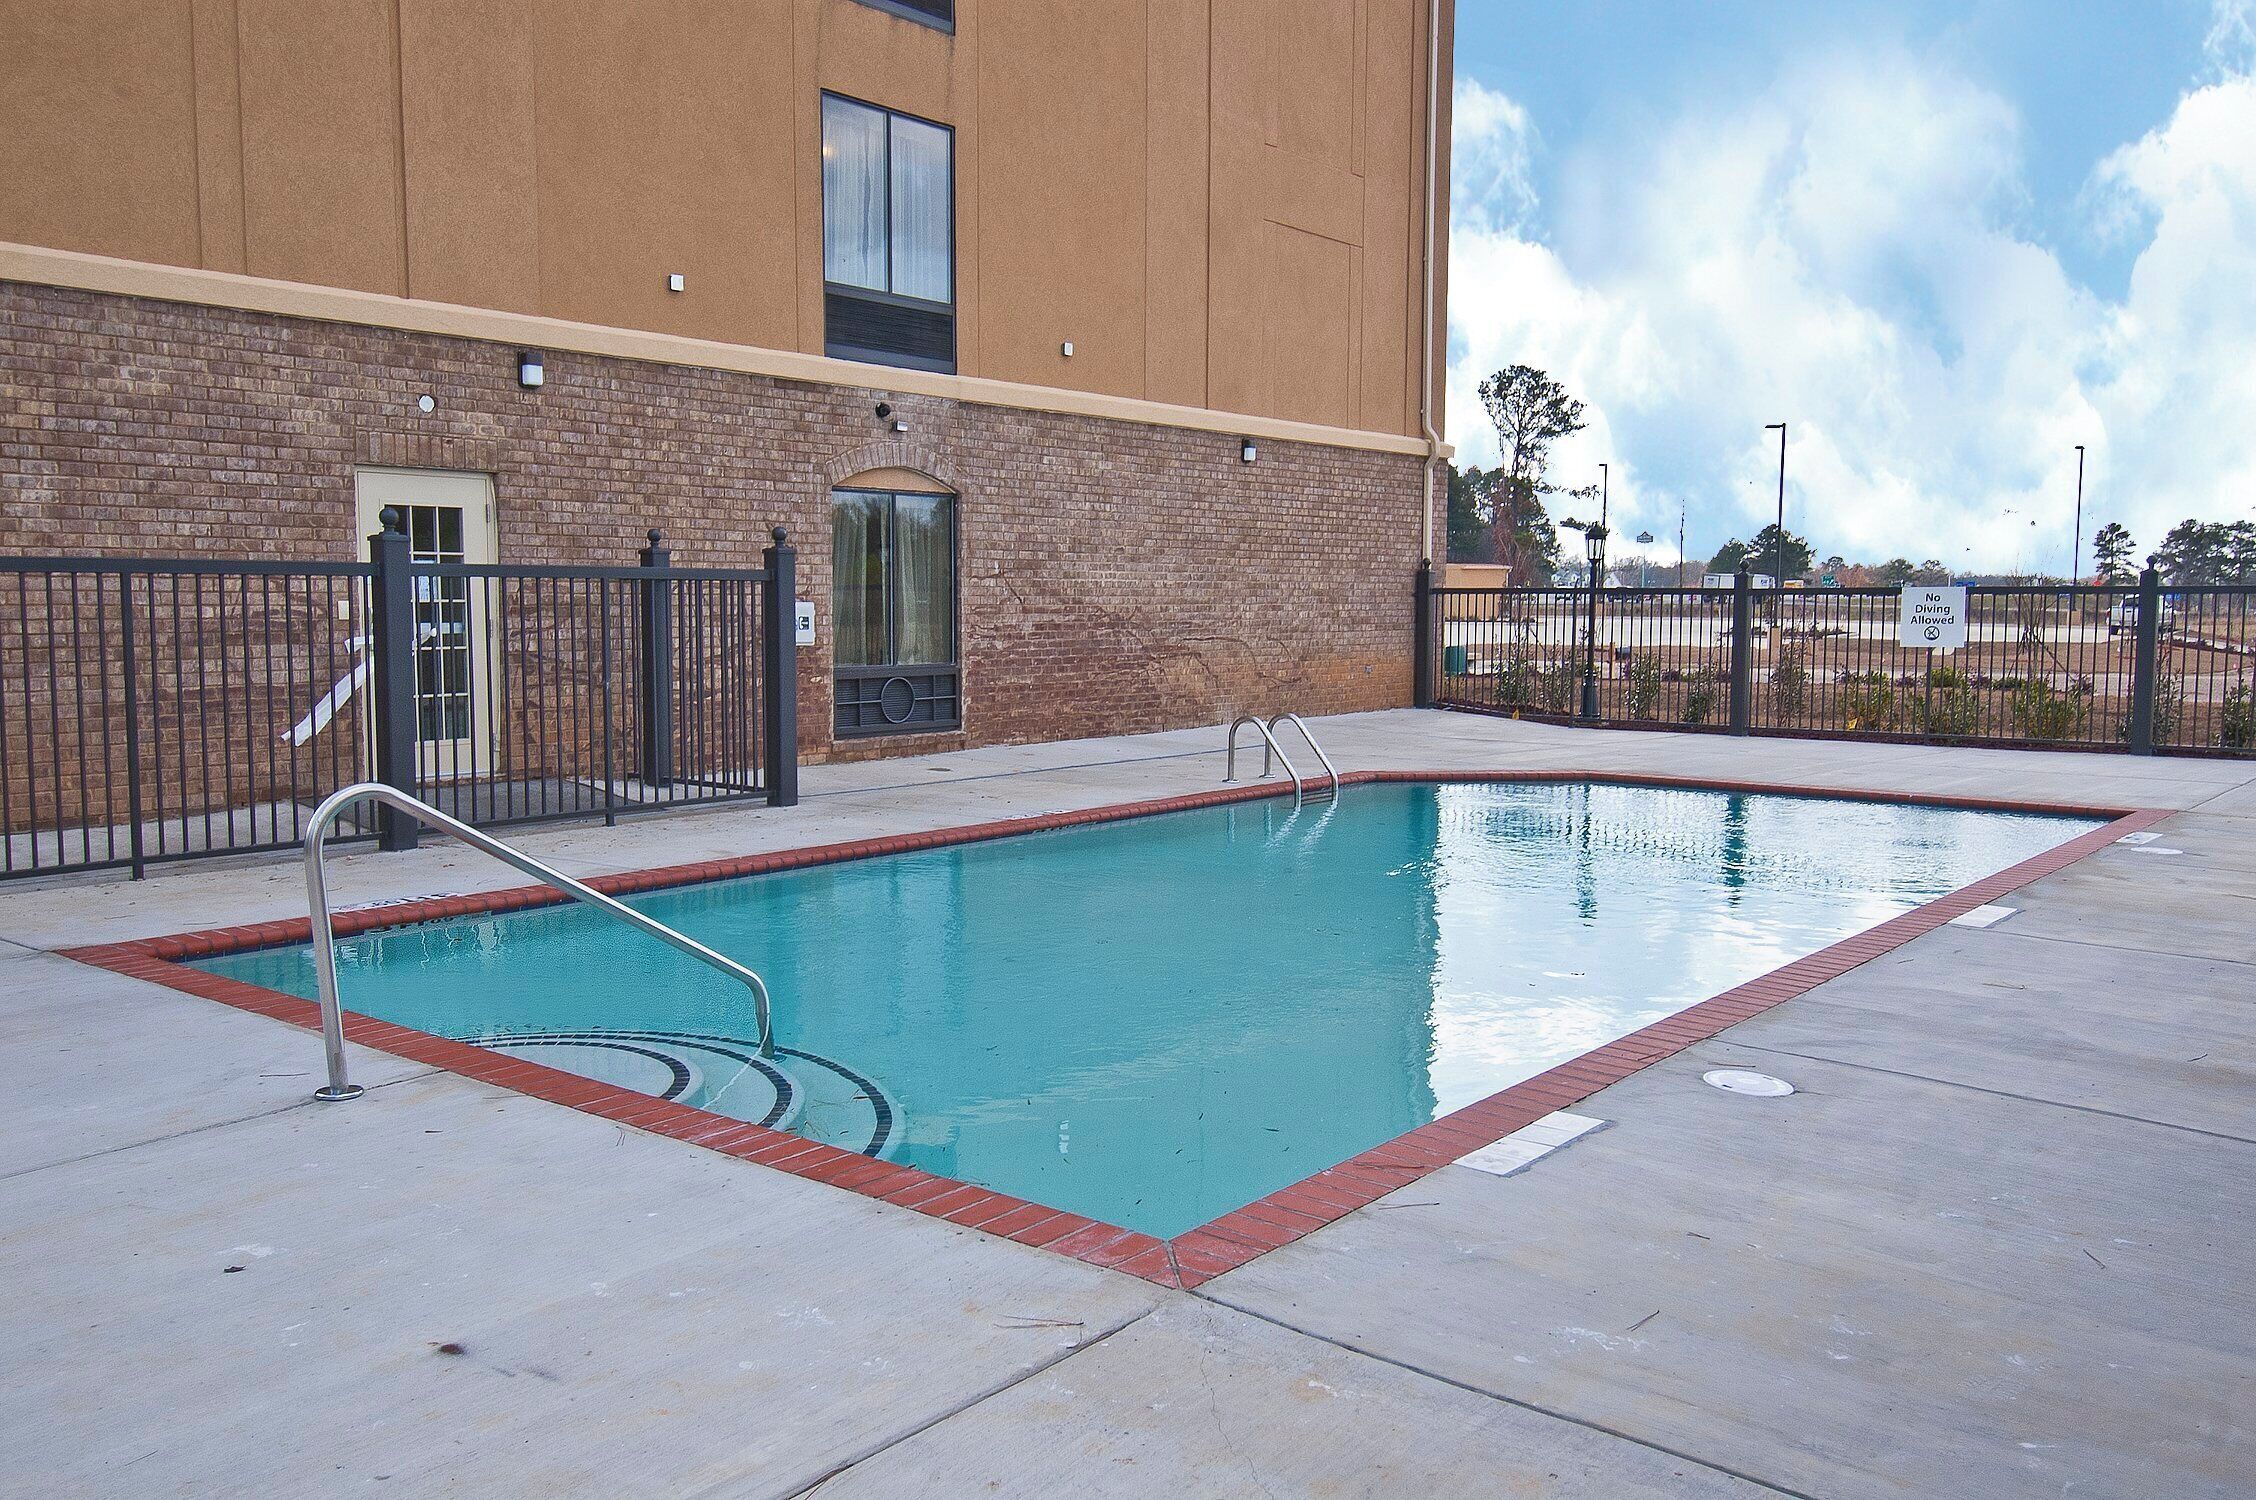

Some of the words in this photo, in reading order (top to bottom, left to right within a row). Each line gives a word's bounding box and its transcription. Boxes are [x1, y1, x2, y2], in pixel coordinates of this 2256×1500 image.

[1925, 593, 1941, 602] No
[1915, 604, 1950, 615] Diving
[1910, 615, 1954, 625] Allowed
